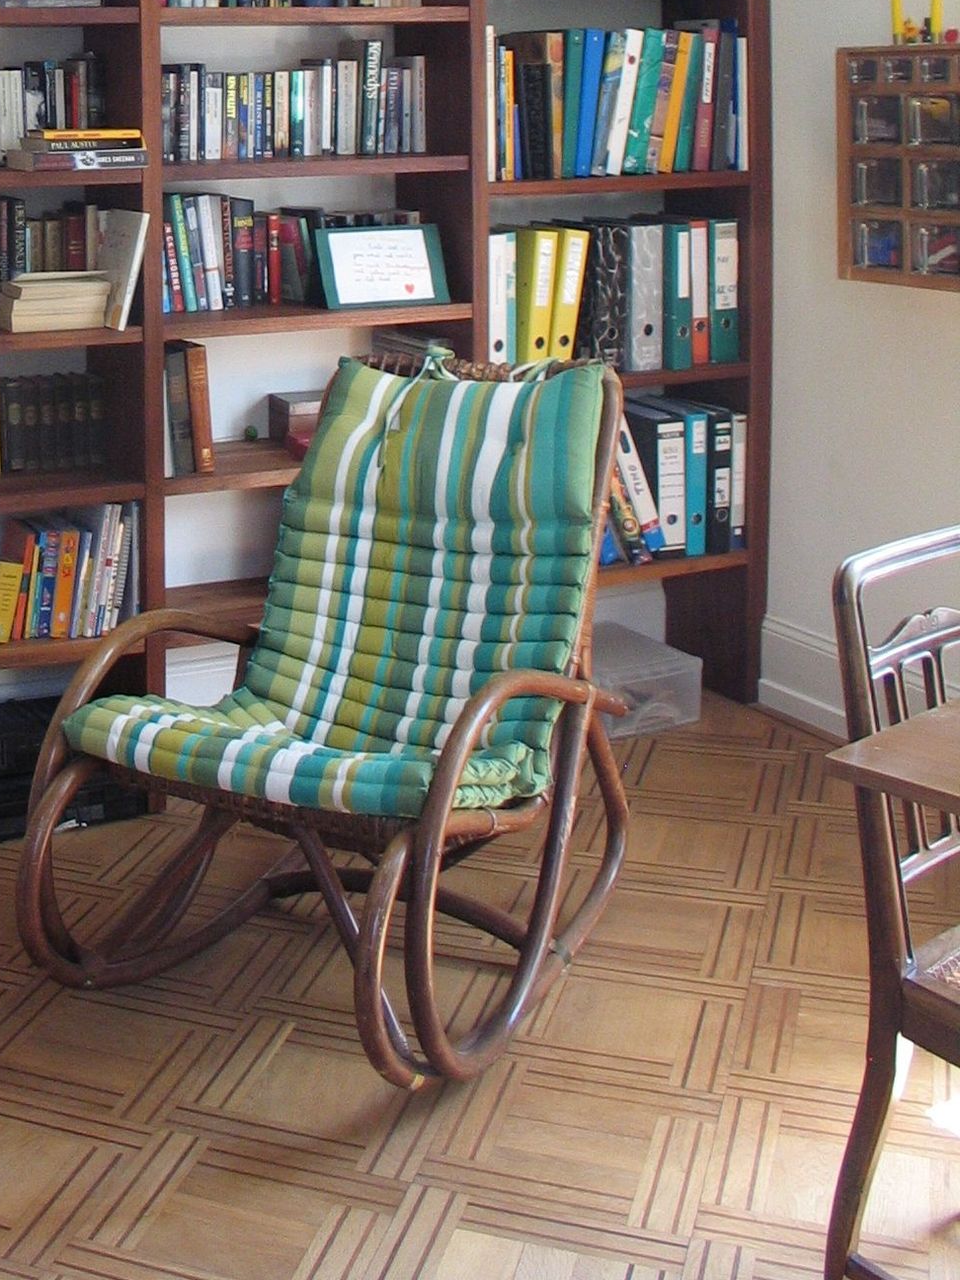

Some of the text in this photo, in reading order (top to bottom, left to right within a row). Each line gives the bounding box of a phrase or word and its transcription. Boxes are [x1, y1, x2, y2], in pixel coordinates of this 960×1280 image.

[363, 40, 382, 100] Kennedys
[51, 141, 98, 150] PAUL AUSTER
